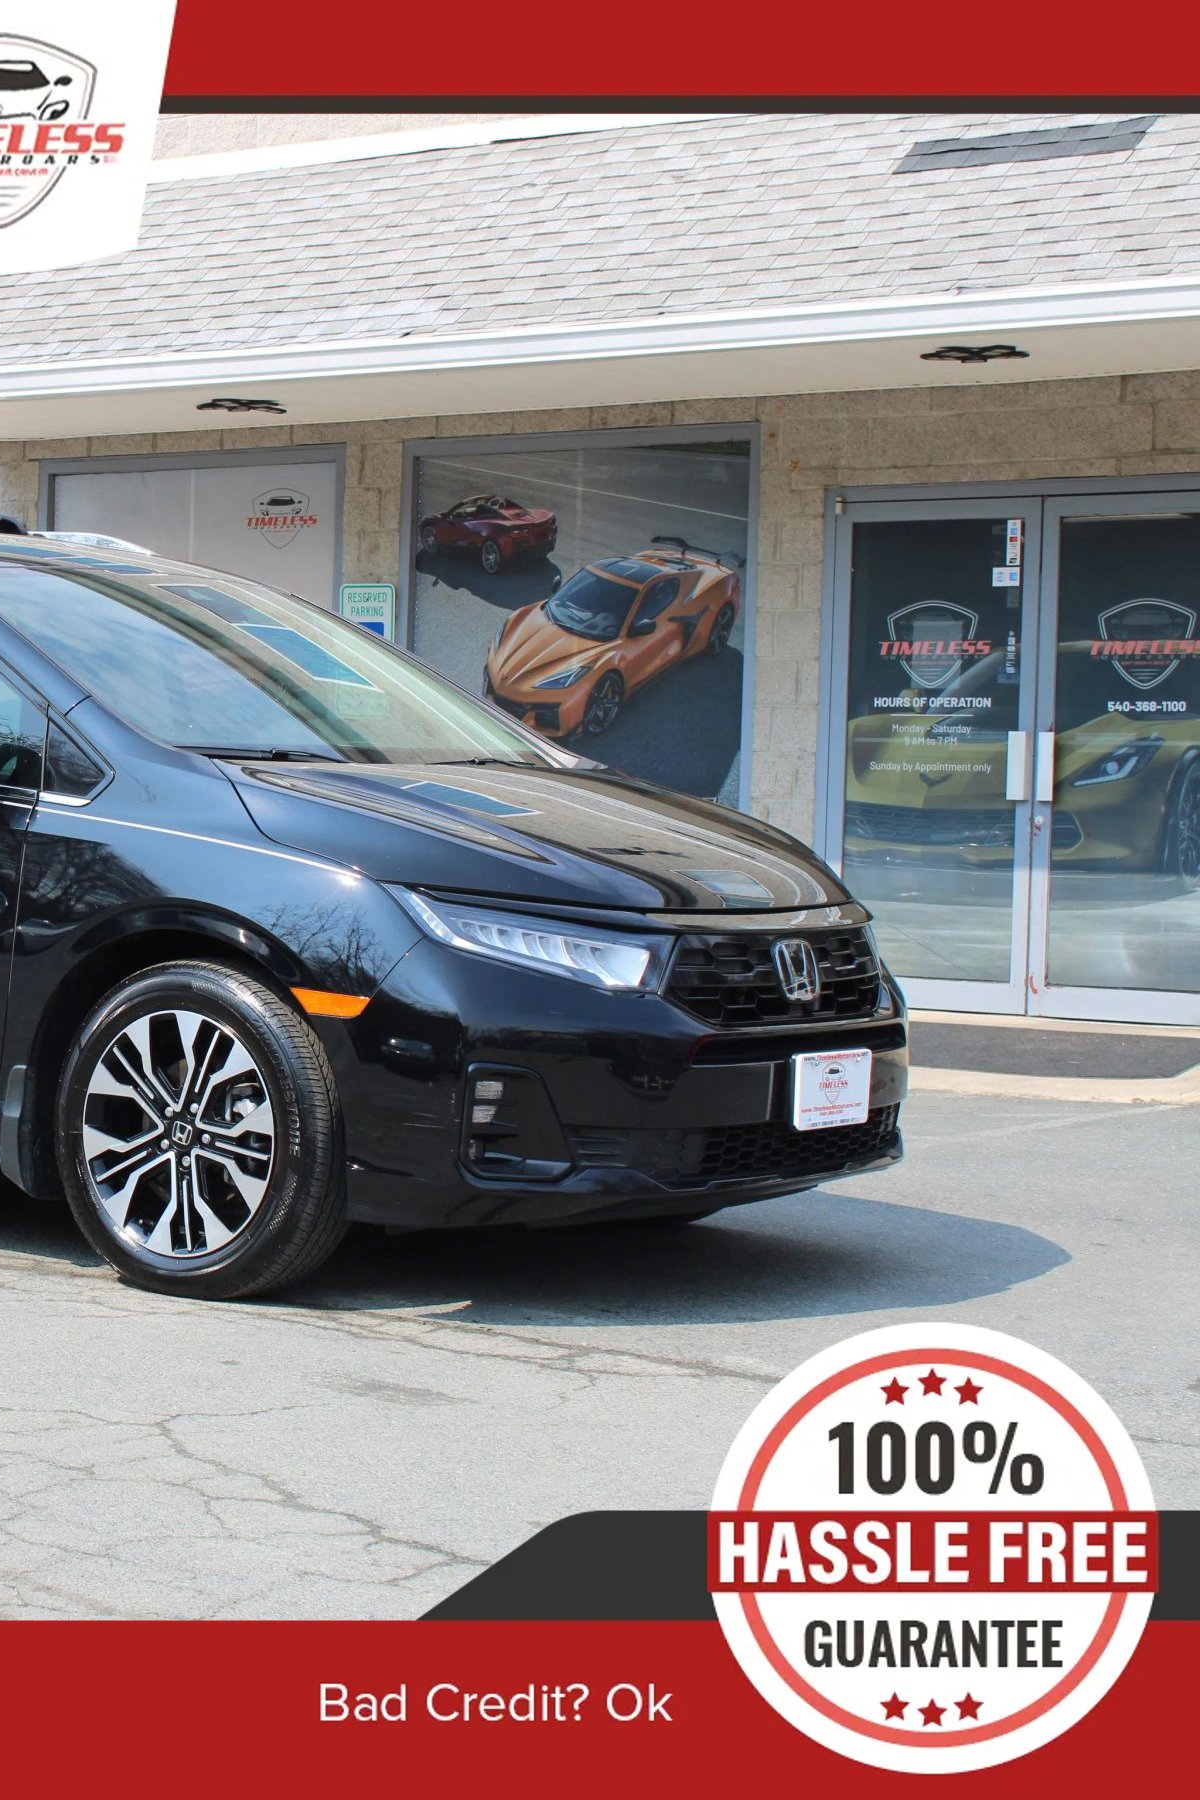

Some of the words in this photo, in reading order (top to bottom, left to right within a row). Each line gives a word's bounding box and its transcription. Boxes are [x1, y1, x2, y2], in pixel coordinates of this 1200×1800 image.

[247, 515, 318, 527] TIMELESS
[347, 592, 388, 603] RESERVED
[350, 606, 384, 617] PARKING
[878, 640, 993, 656] TIMELESS
[873, 697, 911, 708] HOURS
[912, 697, 927, 708] OF
[928, 697, 992, 708] OPERATION
[1107, 701, 1187, 712] 540-368-1100
[891, 724, 927, 735] Monday
[932, 724, 972, 736] Saturday
[911, 737, 925, 746] AM
[926, 738, 936, 746] to
[937, 737, 943, 746] 7
[944, 737, 958, 746] PM
[869, 761, 901, 772] Sunday
[902, 761, 914, 773] by
[914, 762, 971, 773] Appointment
[972, 763, 992, 774] only
[819, 1080, 849, 1090] TIMELESS
